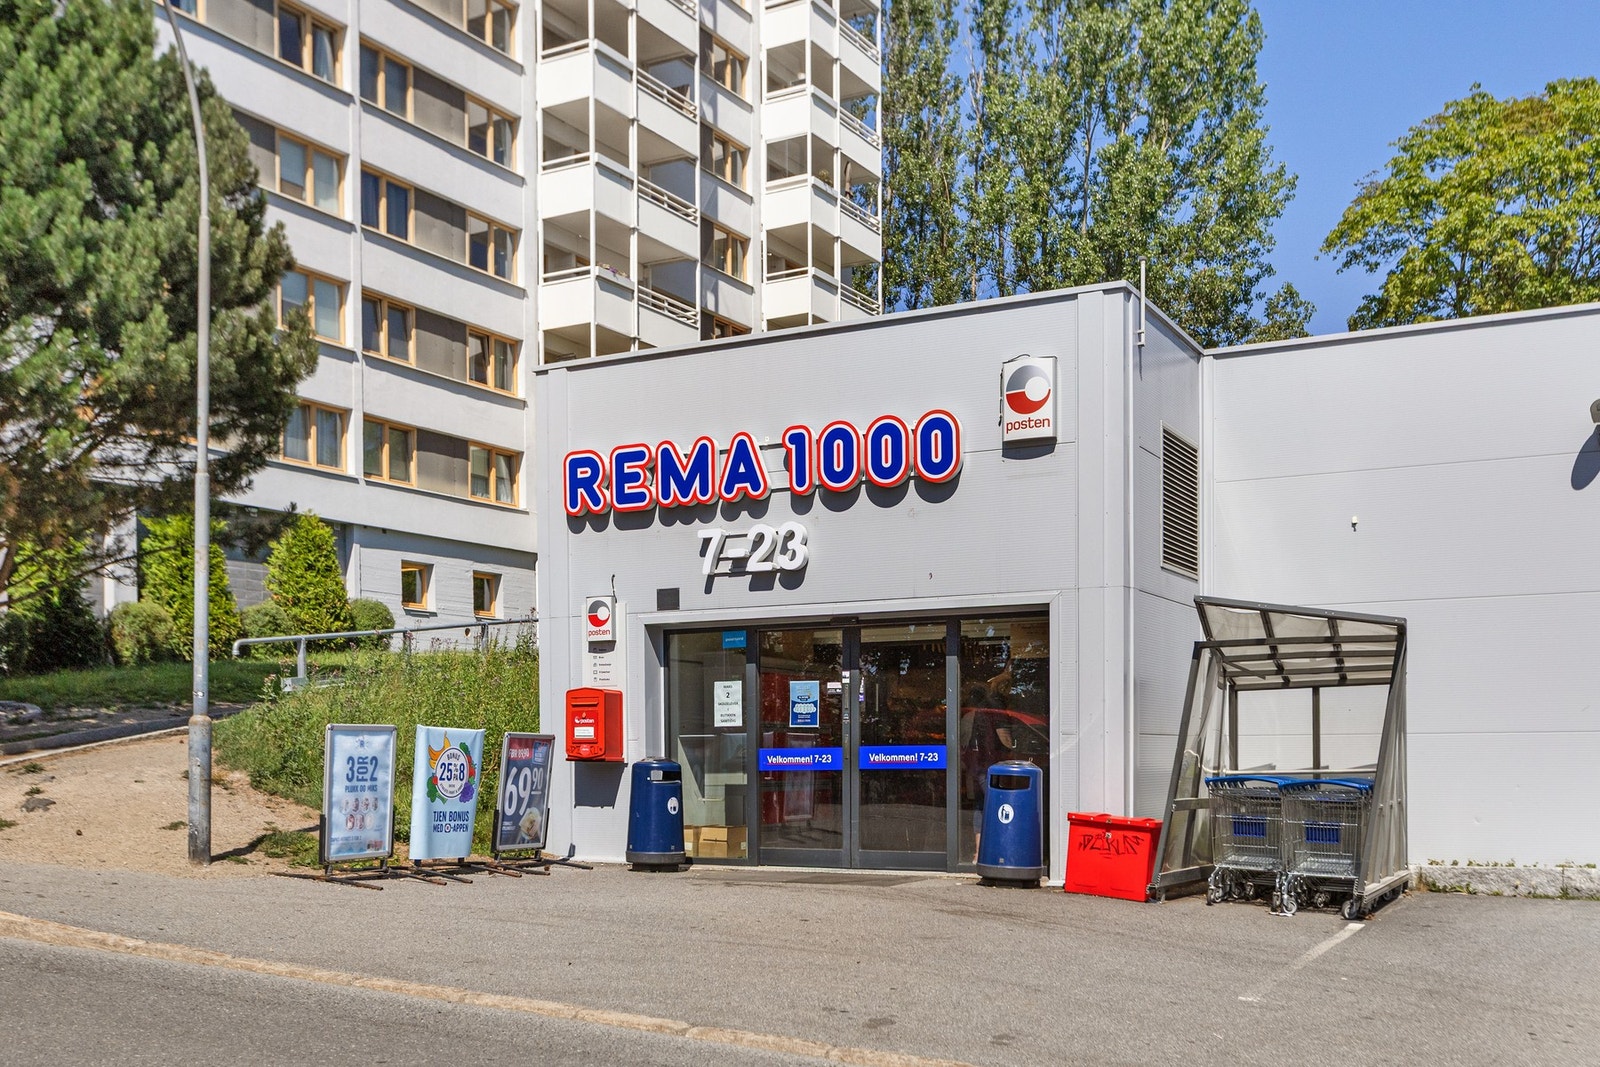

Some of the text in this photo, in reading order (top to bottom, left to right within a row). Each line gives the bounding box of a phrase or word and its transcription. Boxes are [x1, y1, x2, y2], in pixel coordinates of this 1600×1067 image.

[1006, 416, 1051, 434] posten
[564, 408, 962, 517] REMA 1000
[697, 520, 809, 576] 7-23
[588, 628, 611, 637] posten
[446, 752, 461, 761] BONUS
[767, 754, 832, 764] Velkommen! 7-23
[869, 752, 938, 763] Velkommen! 7-23
[346, 755, 379, 782] 3 FOR 2
[439, 762, 453, 781] 25
[459, 763, 465, 781] 8
[345, 785, 358, 793] PLUKK
[367, 784, 378, 792] MIKS
[504, 766, 532, 816] 69
[433, 810, 470, 822] TJEN BONUS
[433, 823, 443, 832] MED
